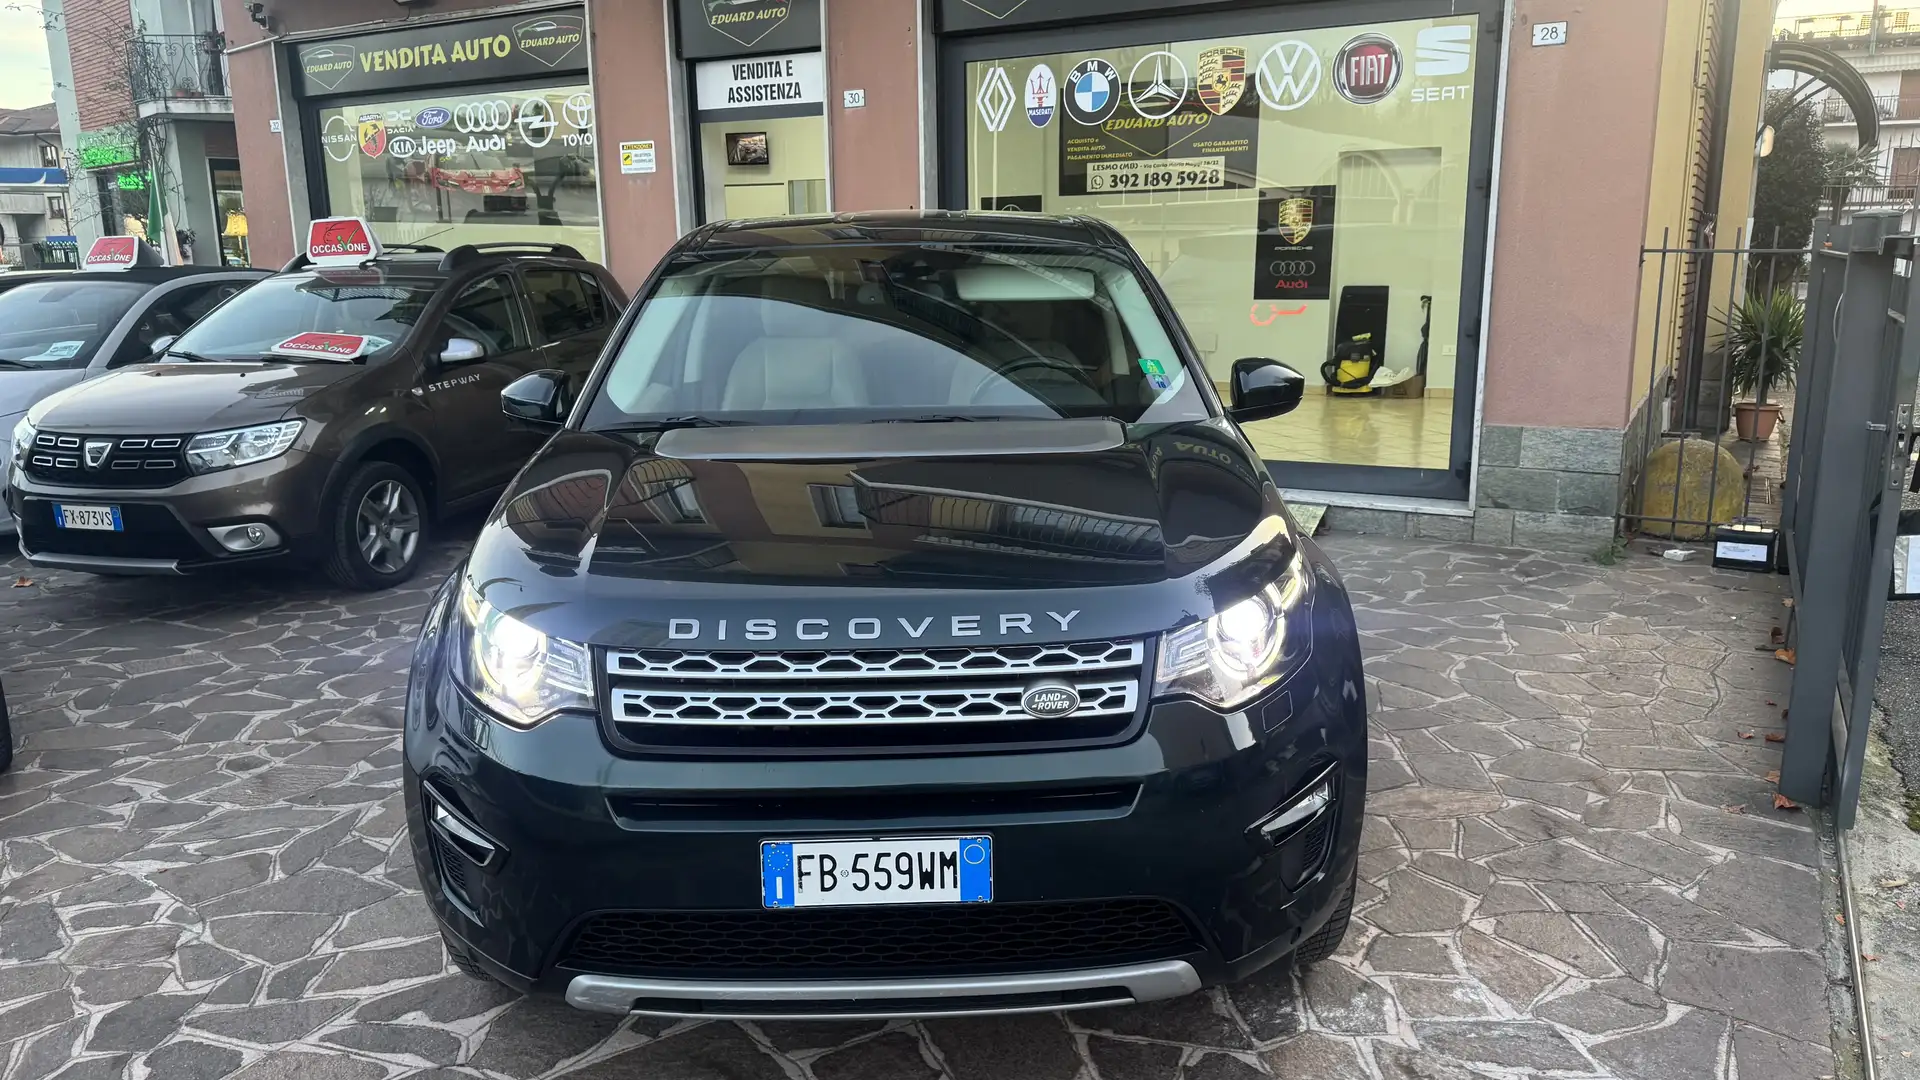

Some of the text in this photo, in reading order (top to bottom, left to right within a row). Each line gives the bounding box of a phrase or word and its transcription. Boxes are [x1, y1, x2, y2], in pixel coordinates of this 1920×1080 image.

[709, 7, 786, 26] EDUARD AUTO
[520, 33, 580, 49] EDUARD AUTO
[1540, 27, 1559, 41] 28
[359, 34, 511, 73] VENDITA AUTO
[1199, 47, 1245, 60] PORSCHE
[306, 60, 353, 73] EDUARD AUTO
[731, 59, 794, 81] VENDITA E
[1069, 60, 1117, 84] BMW
[1350, 53, 1389, 87] FIAT
[727, 81, 802, 104] ASSISTENZA
[848, 92, 860, 104] 30
[1410, 85, 1470, 102] SEAT
[421, 110, 444, 126] Ford
[1028, 108, 1053, 116] MASERATI
[1105, 113, 1208, 131] EDUARD AUTO
[321, 134, 357, 144] NISSAN
[387, 127, 414, 135] DACIA
[392, 140, 413, 153] KIA
[418, 135, 456, 157] Jeep
[465, 133, 506, 153] Audi
[1092, 163, 1119, 171] LESMO
[1109, 169, 1220, 188] 392 189 5928
[428, 373, 481, 392] STEPWAY
[668, 609, 1081, 641] DISCOVERY
[1034, 692, 1061, 702] LAND
[1037, 700, 1070, 710] ROVER
